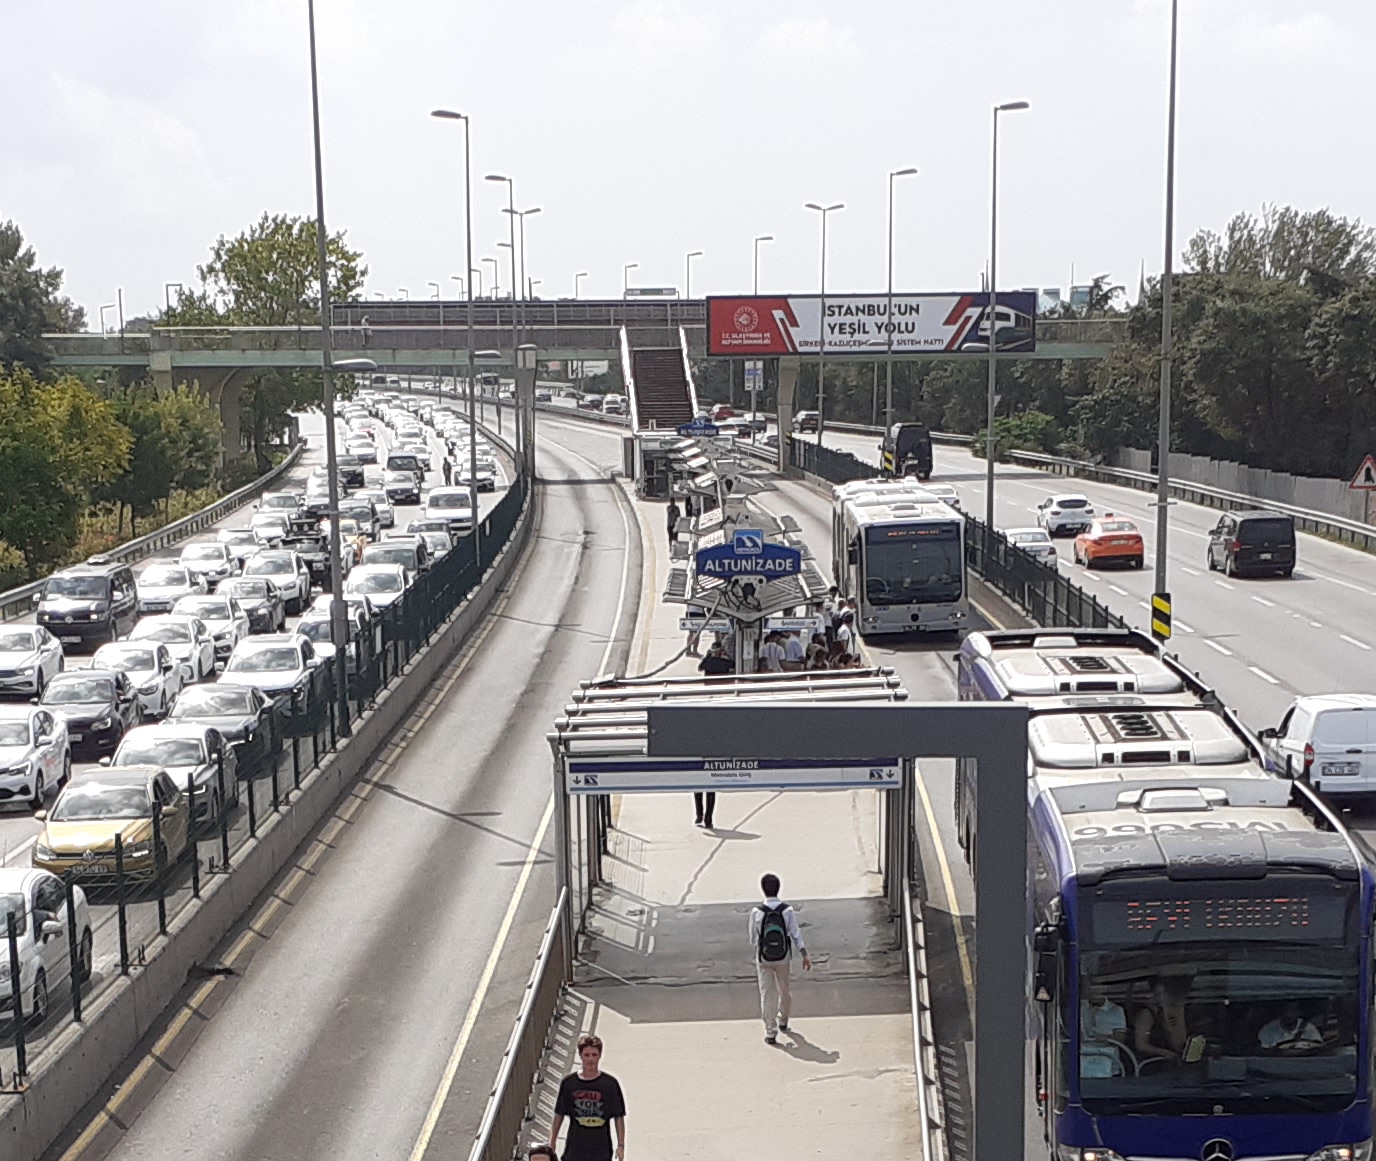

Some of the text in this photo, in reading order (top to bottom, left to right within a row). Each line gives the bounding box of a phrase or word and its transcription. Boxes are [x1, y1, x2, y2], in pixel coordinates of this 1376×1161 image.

[827, 318, 916, 338] YEŞİL YOLU
[704, 555, 794, 572] ALTUNİZADE
[703, 759, 759, 770] ALTUNİZADE
